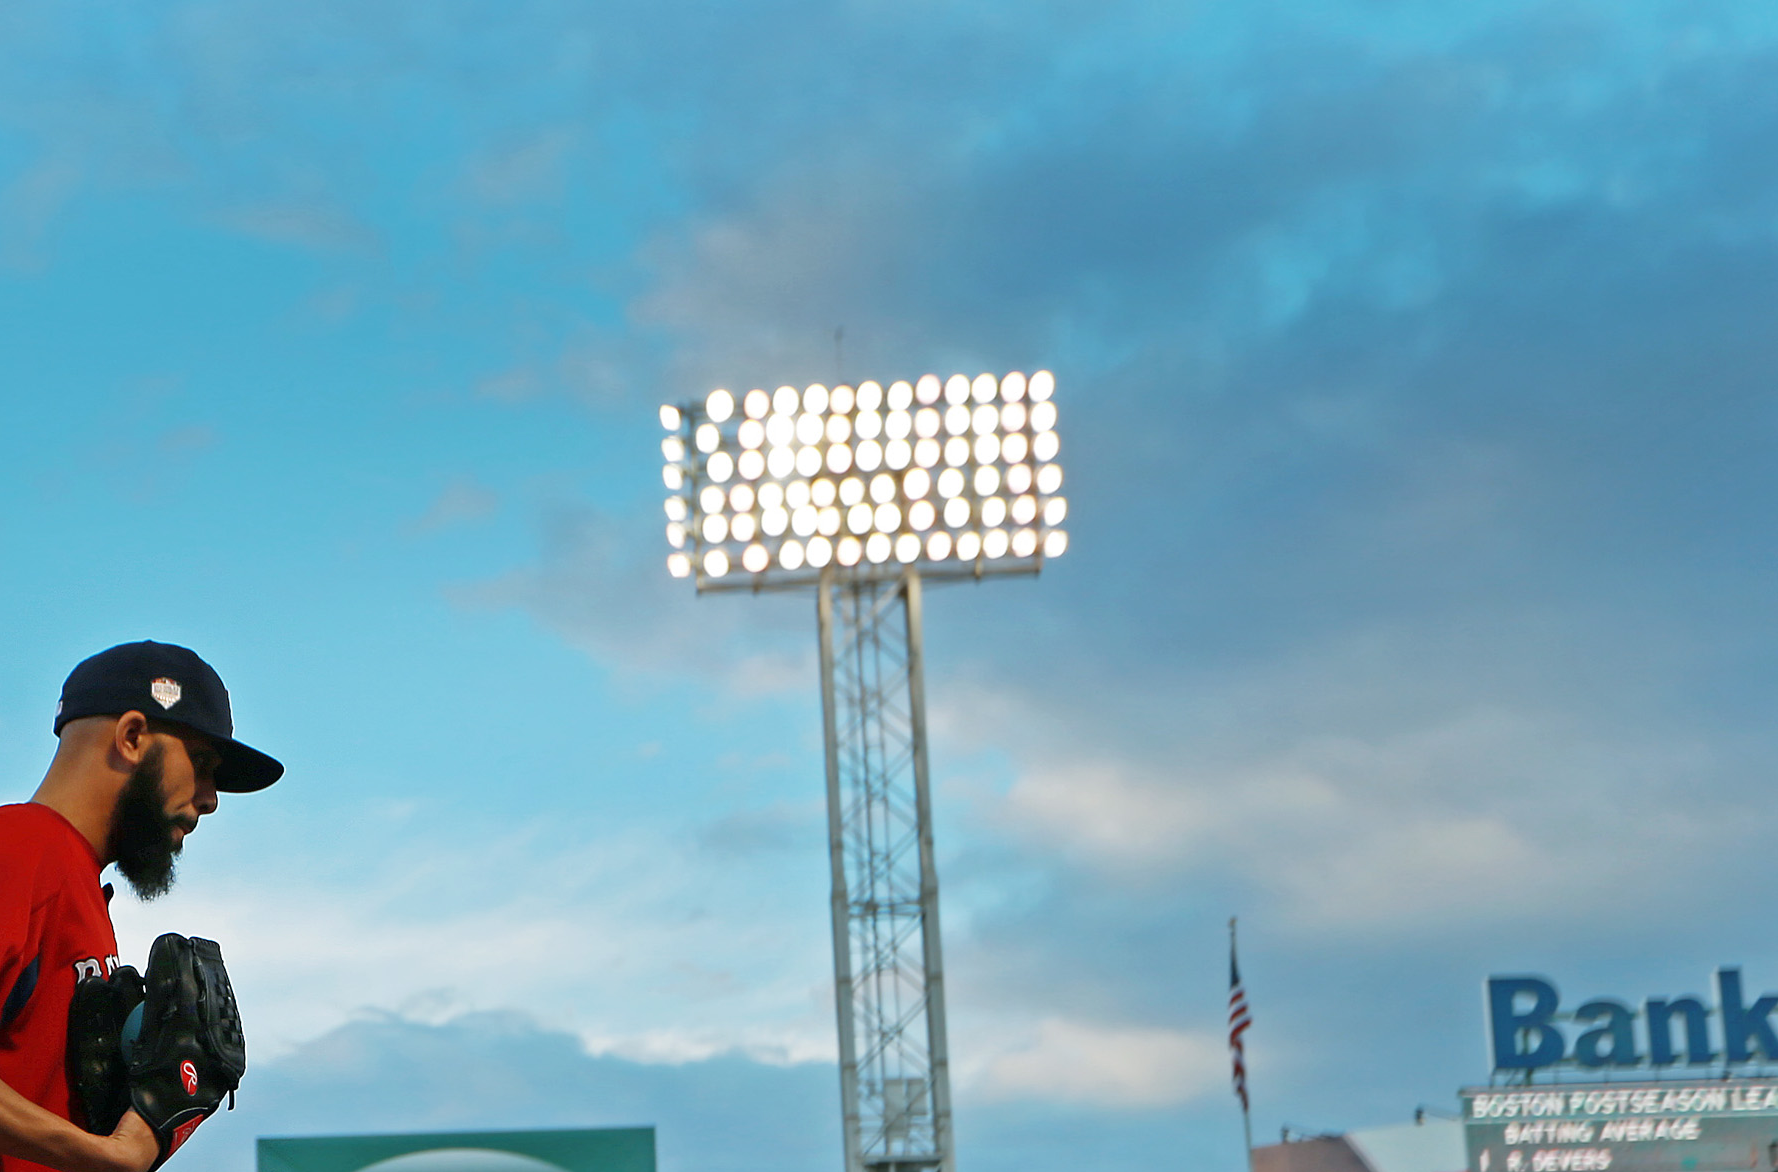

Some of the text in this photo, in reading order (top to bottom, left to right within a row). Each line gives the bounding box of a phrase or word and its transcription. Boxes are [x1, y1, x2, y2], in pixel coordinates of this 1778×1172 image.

[1484, 966, 1778, 1068] Bank
[1473, 1092, 1565, 1118] BOSTON
[1570, 1087, 1727, 1114] POSTSEASON
[1504, 1115, 1702, 1145] BATTING AVERAGE
[1479, 1149, 1490, 1172] 1
[1532, 1148, 1613, 1172] DEVERS
